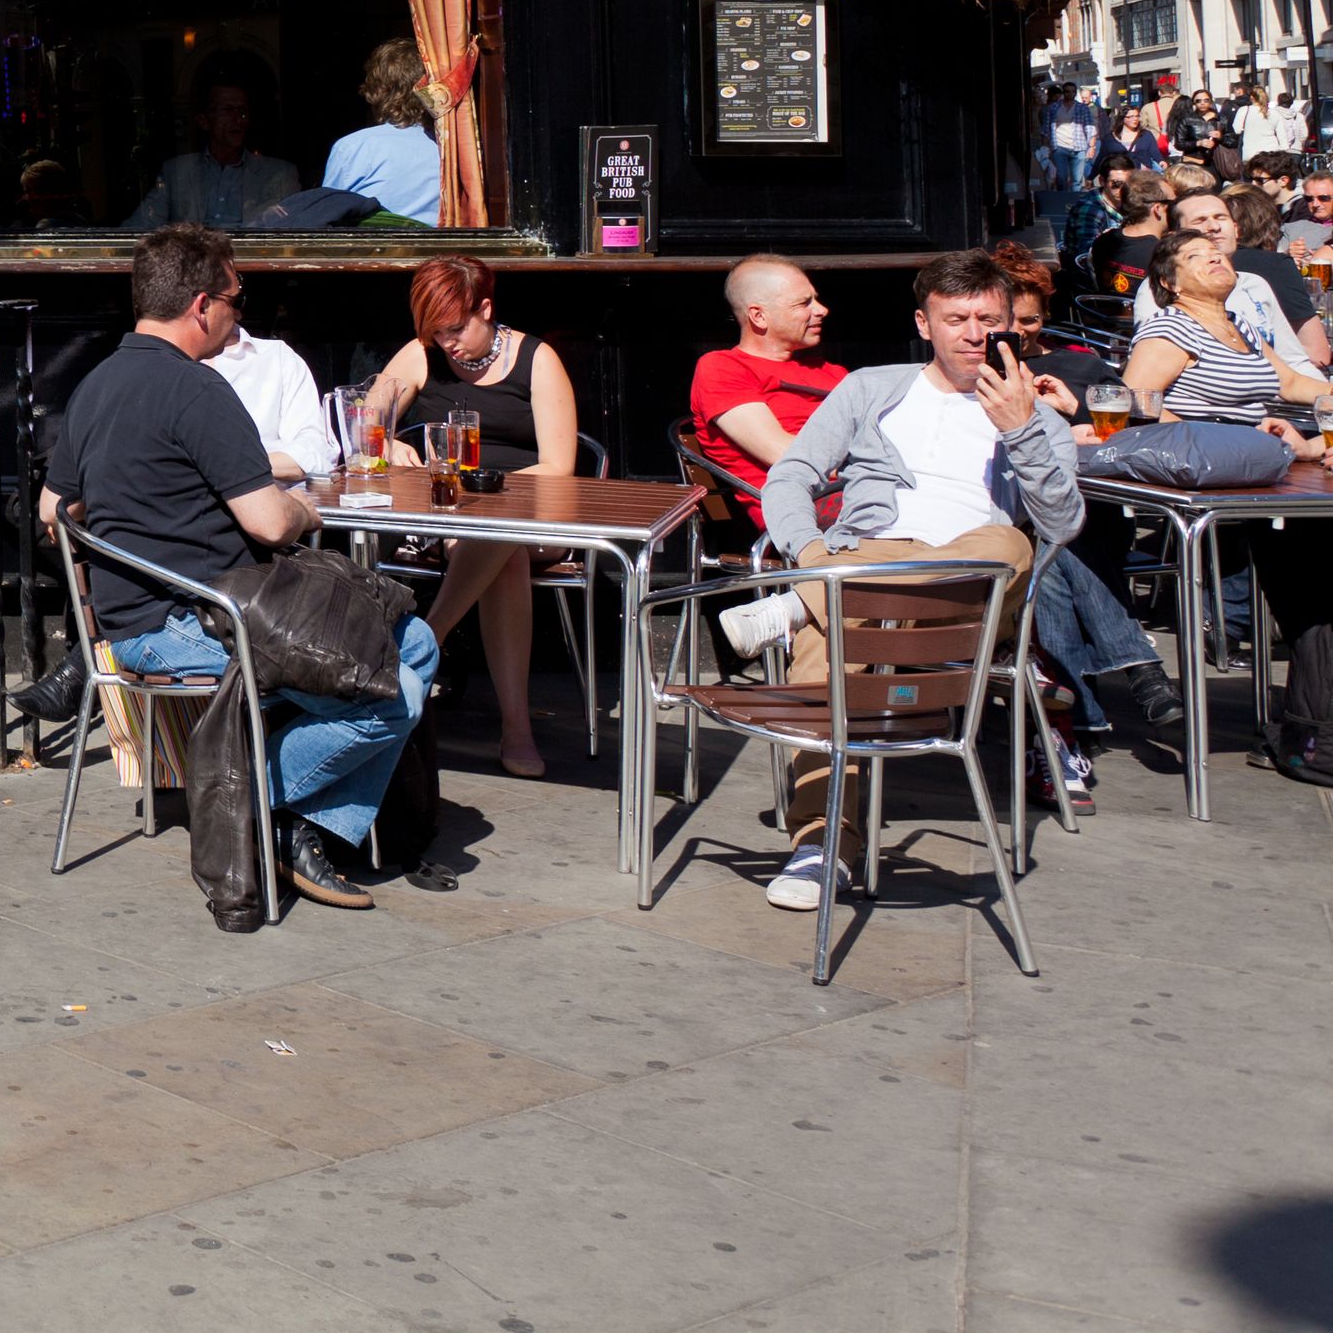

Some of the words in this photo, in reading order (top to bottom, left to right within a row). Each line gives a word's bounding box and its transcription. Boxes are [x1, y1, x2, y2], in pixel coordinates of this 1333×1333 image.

[607, 155, 640, 166] GREAT
[601, 166, 644, 177] BRITISH
[612, 177, 633, 187] PUB
[609, 187, 636, 199] FOOD
